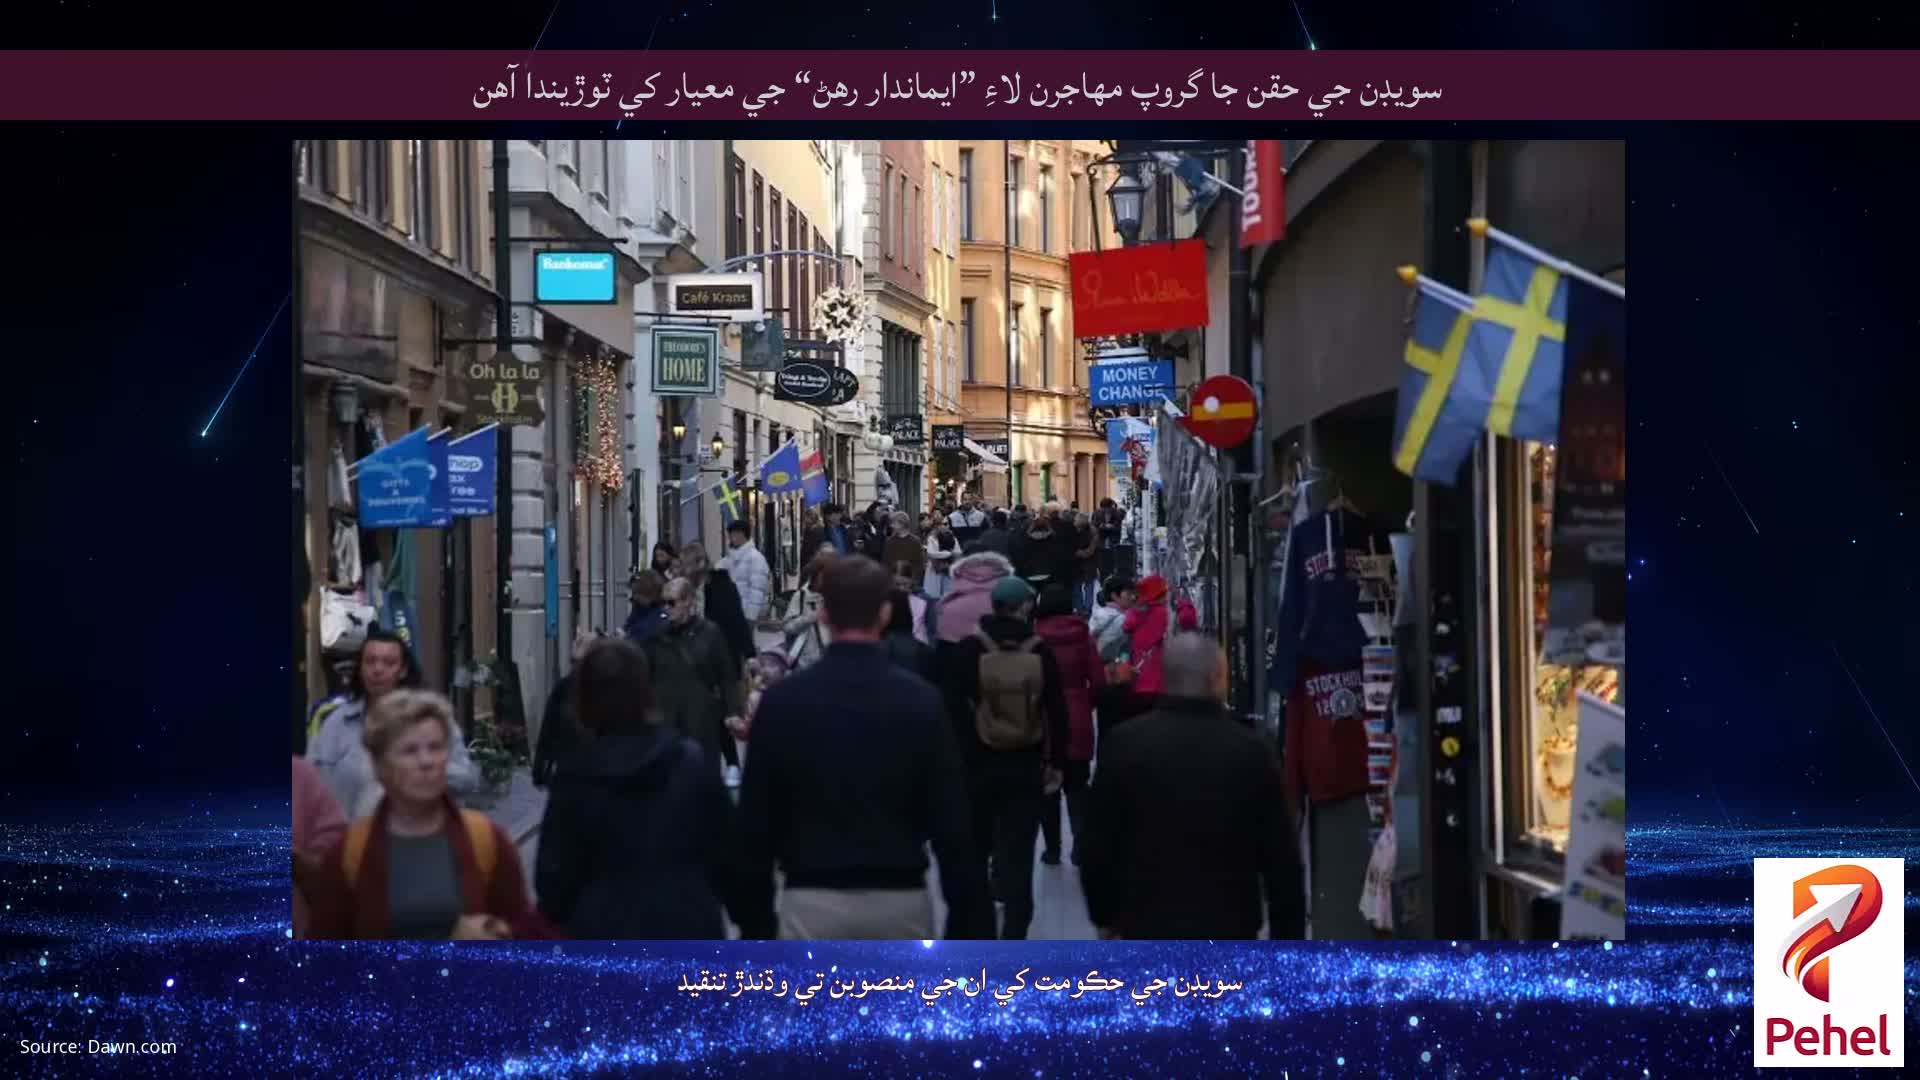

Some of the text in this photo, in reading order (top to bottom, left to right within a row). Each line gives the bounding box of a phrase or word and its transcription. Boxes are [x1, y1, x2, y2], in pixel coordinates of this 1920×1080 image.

[681, 290, 747, 304] Café Krans
[470, 363, 540, 380] Oh la la
[663, 357, 706, 382] HOME
[1102, 365, 1159, 384] MONEY
[1098, 383, 1166, 401] CHANGE
[934, 439, 961, 449] PALACE
